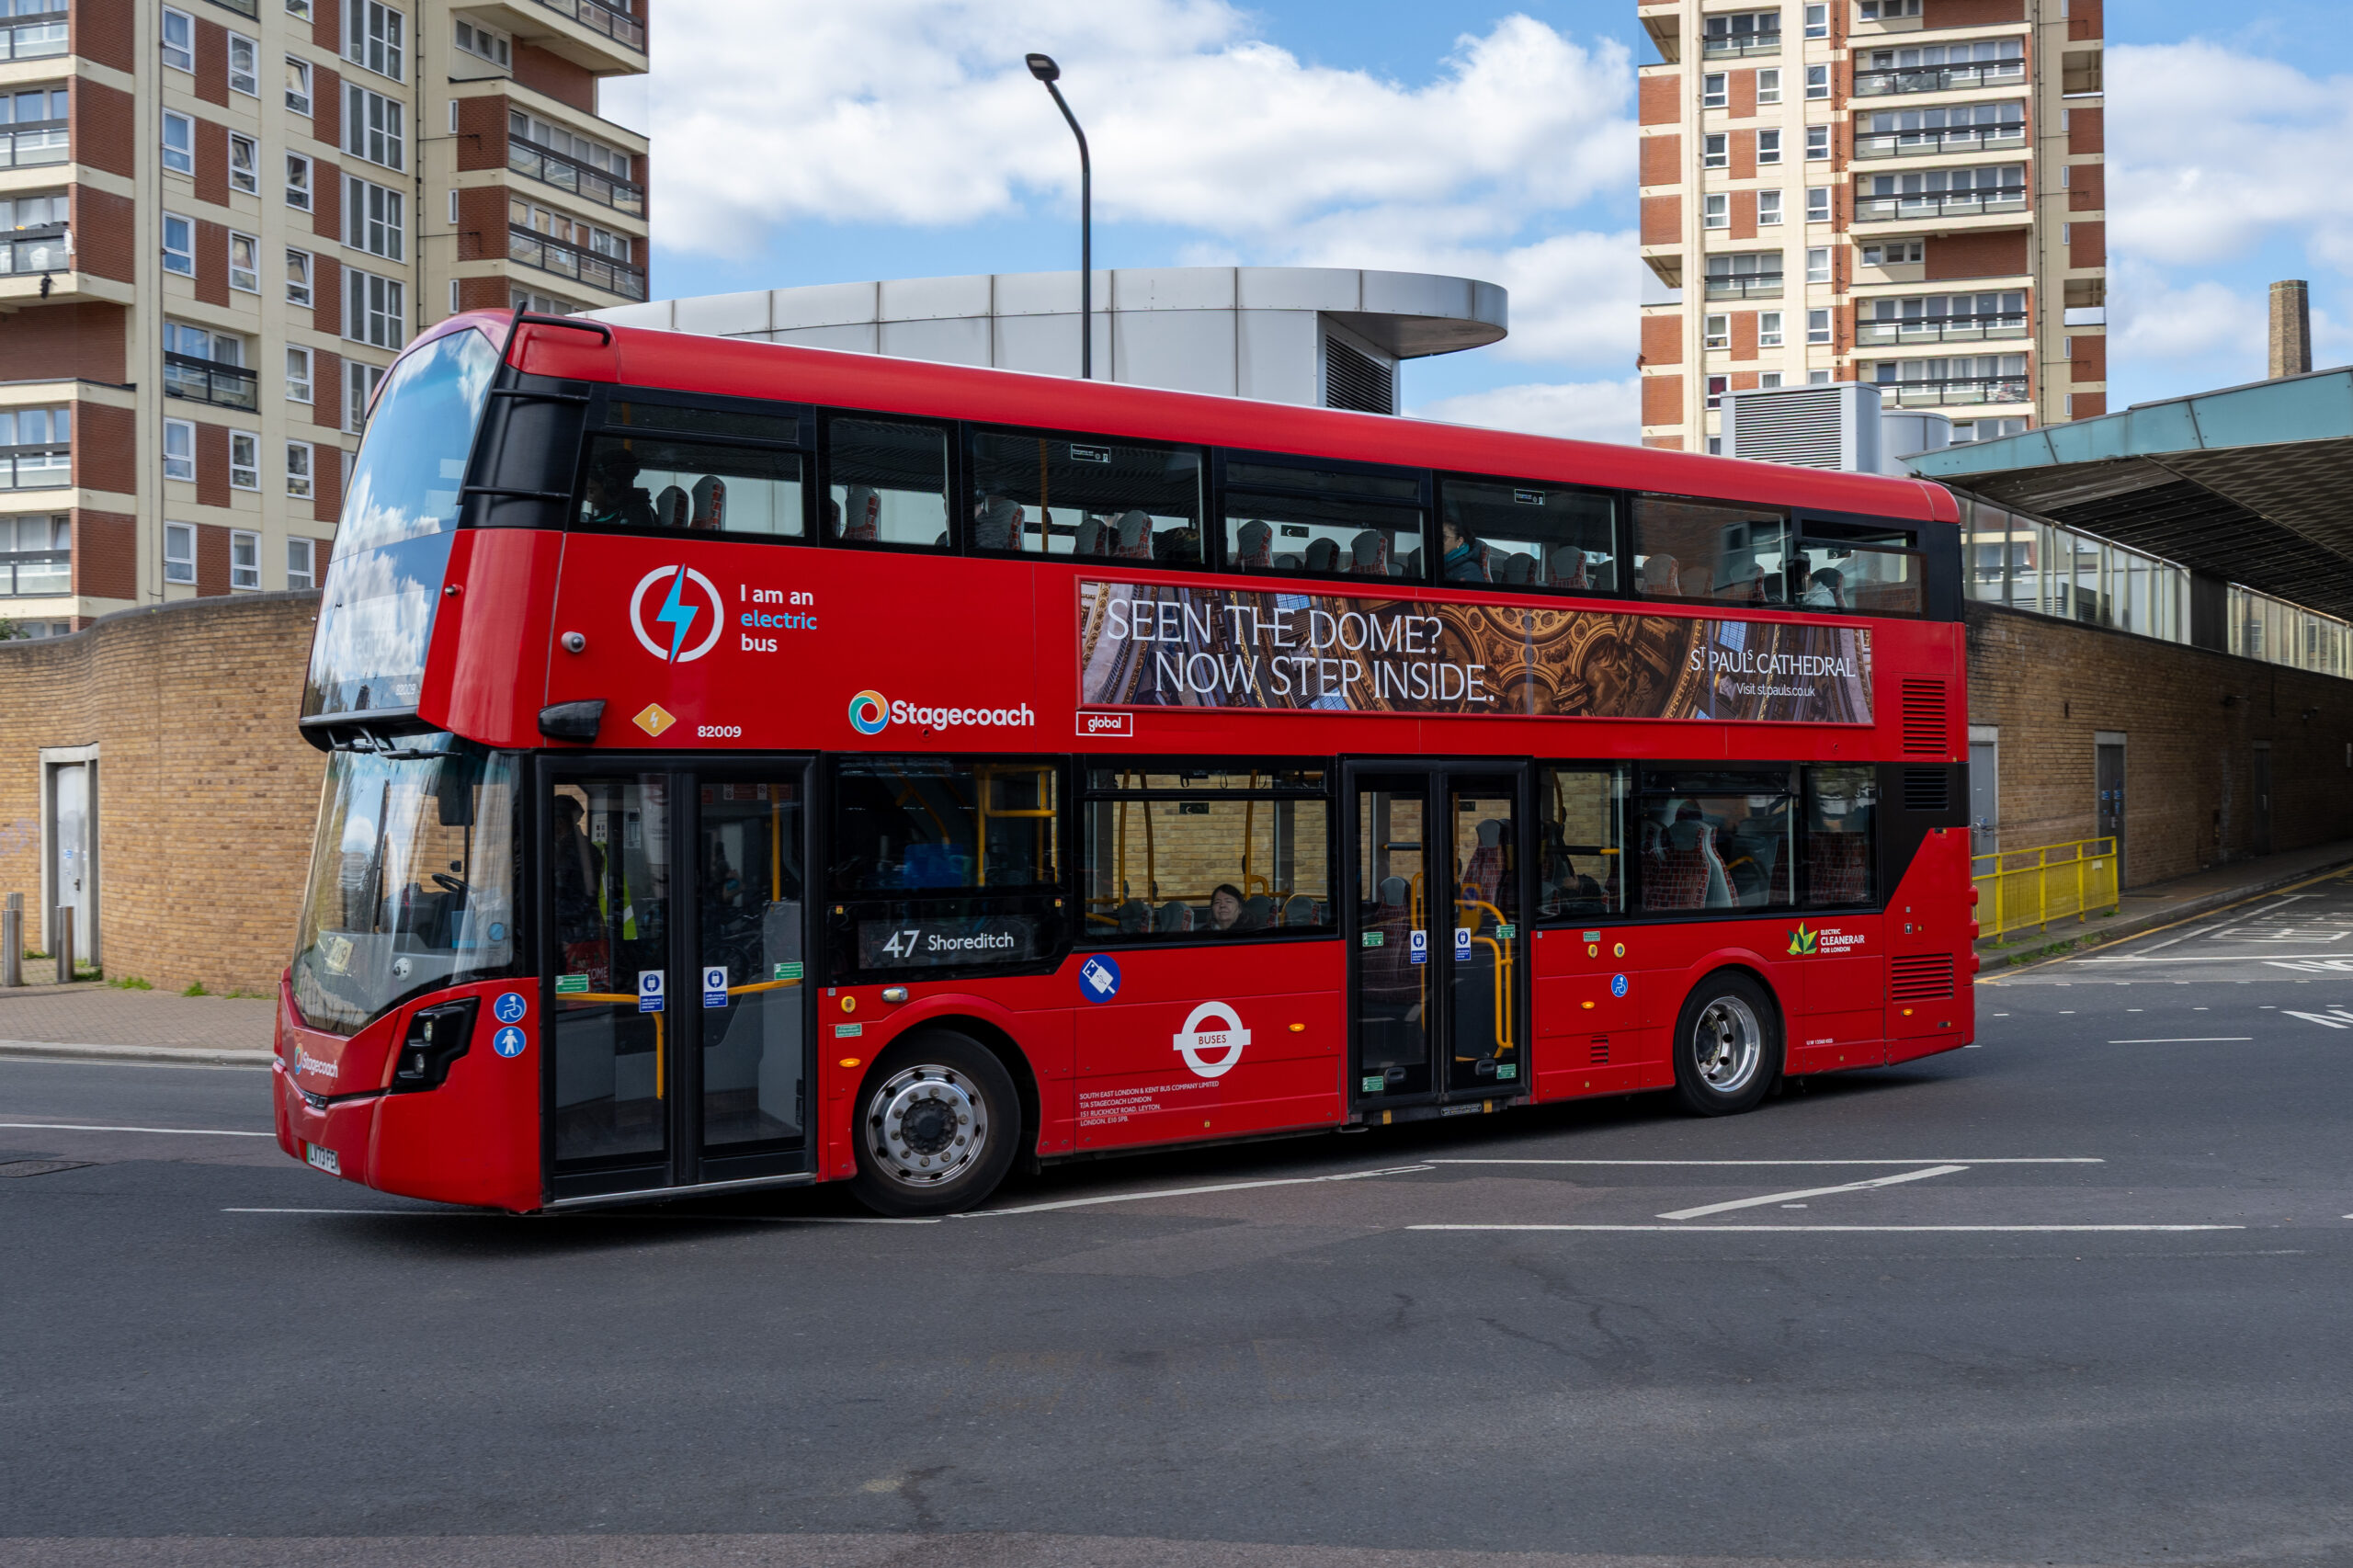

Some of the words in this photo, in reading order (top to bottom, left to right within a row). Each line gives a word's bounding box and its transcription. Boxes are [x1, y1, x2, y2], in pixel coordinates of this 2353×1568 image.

[741, 584, 746, 602] I
[752, 589, 783, 604] am
[790, 591, 813, 606] an
[741, 609, 817, 631] electric
[1107, 598, 1211, 643] SEEN
[1224, 603, 1297, 647] THE
[1308, 609, 1443, 655] DOME?
[741, 633, 778, 653] bus
[1756, 653, 1857, 677] CATHEDRAL
[1154, 651, 1258, 694] NOW
[1270, 655, 1362, 698] STEP
[1373, 661, 1495, 702] INSIDE.
[1736, 682, 1756, 696] Visit
[891, 699, 1035, 731] Stagecoach
[1087, 715, 1121, 733] global
[697, 725, 742, 738] 82009
[882, 929, 920, 959] 47
[927, 931, 1014, 951] Shoreditch
[1198, 1034, 1227, 1045] BUSES
[301, 1051, 338, 1078] Stagecoach
[1079, 1092, 1100, 1100] SOUTH
[1115, 1088, 1140, 1096] LONDON
[1171, 1083, 1199, 1091] COMPANY
[1090, 1099, 1128, 1108] STAGECOACH
[1127, 1096, 1153, 1104] LONDON
[1090, 1108, 1120, 1117] RUCKHOLT
